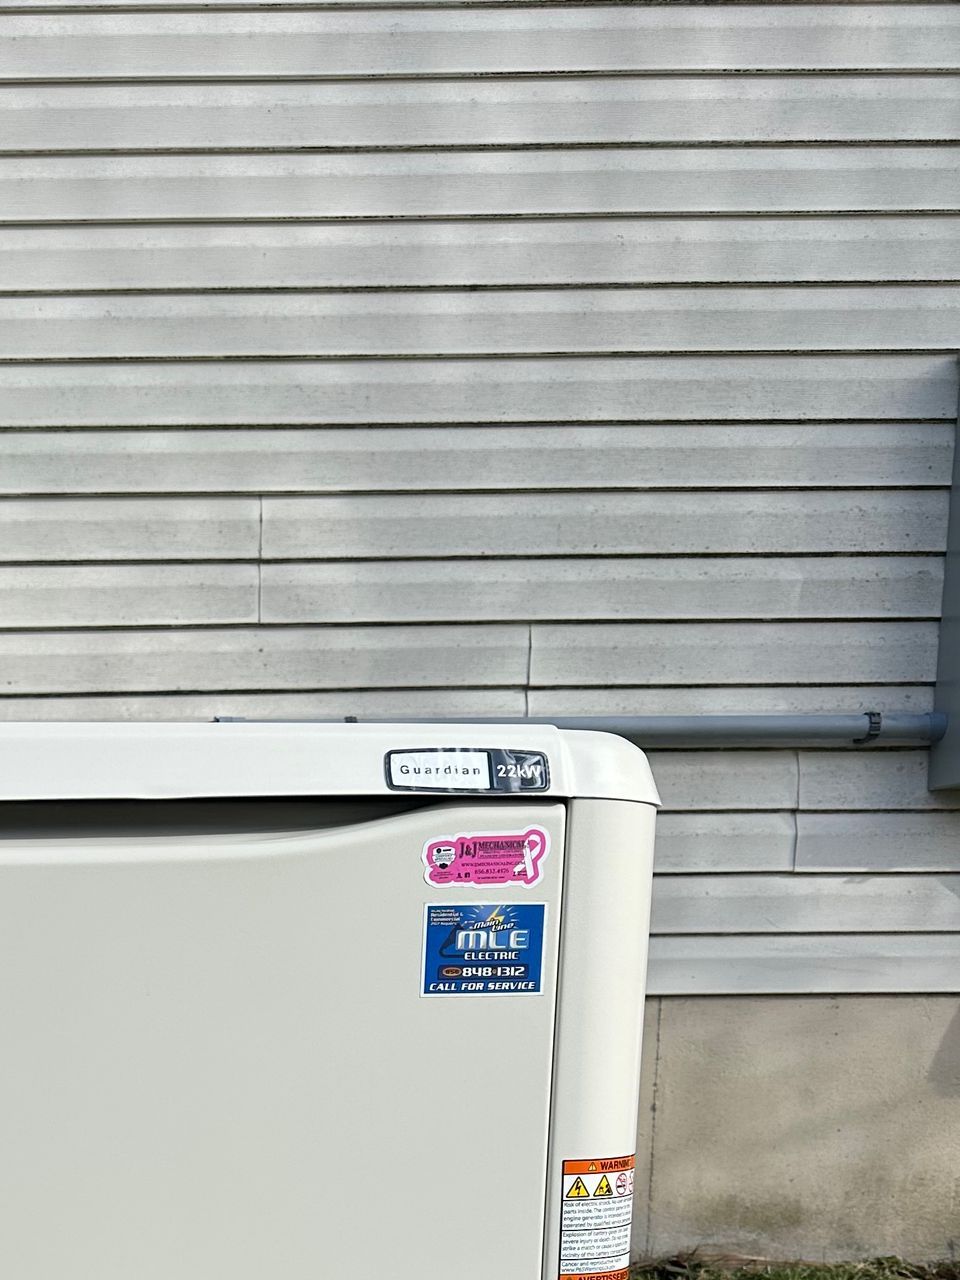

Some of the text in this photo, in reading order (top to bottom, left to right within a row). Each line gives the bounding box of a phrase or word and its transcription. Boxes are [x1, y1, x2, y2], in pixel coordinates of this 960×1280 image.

[400, 765, 541, 778] Guardian 22kW
[459, 842, 478, 858] J&J
[473, 917, 499, 929] Main
[491, 923, 515, 932] Line
[457, 930, 529, 950] MLE
[464, 951, 520, 960] ELECTRIC
[429, 981, 536, 991] CALL FOR SERVICE
